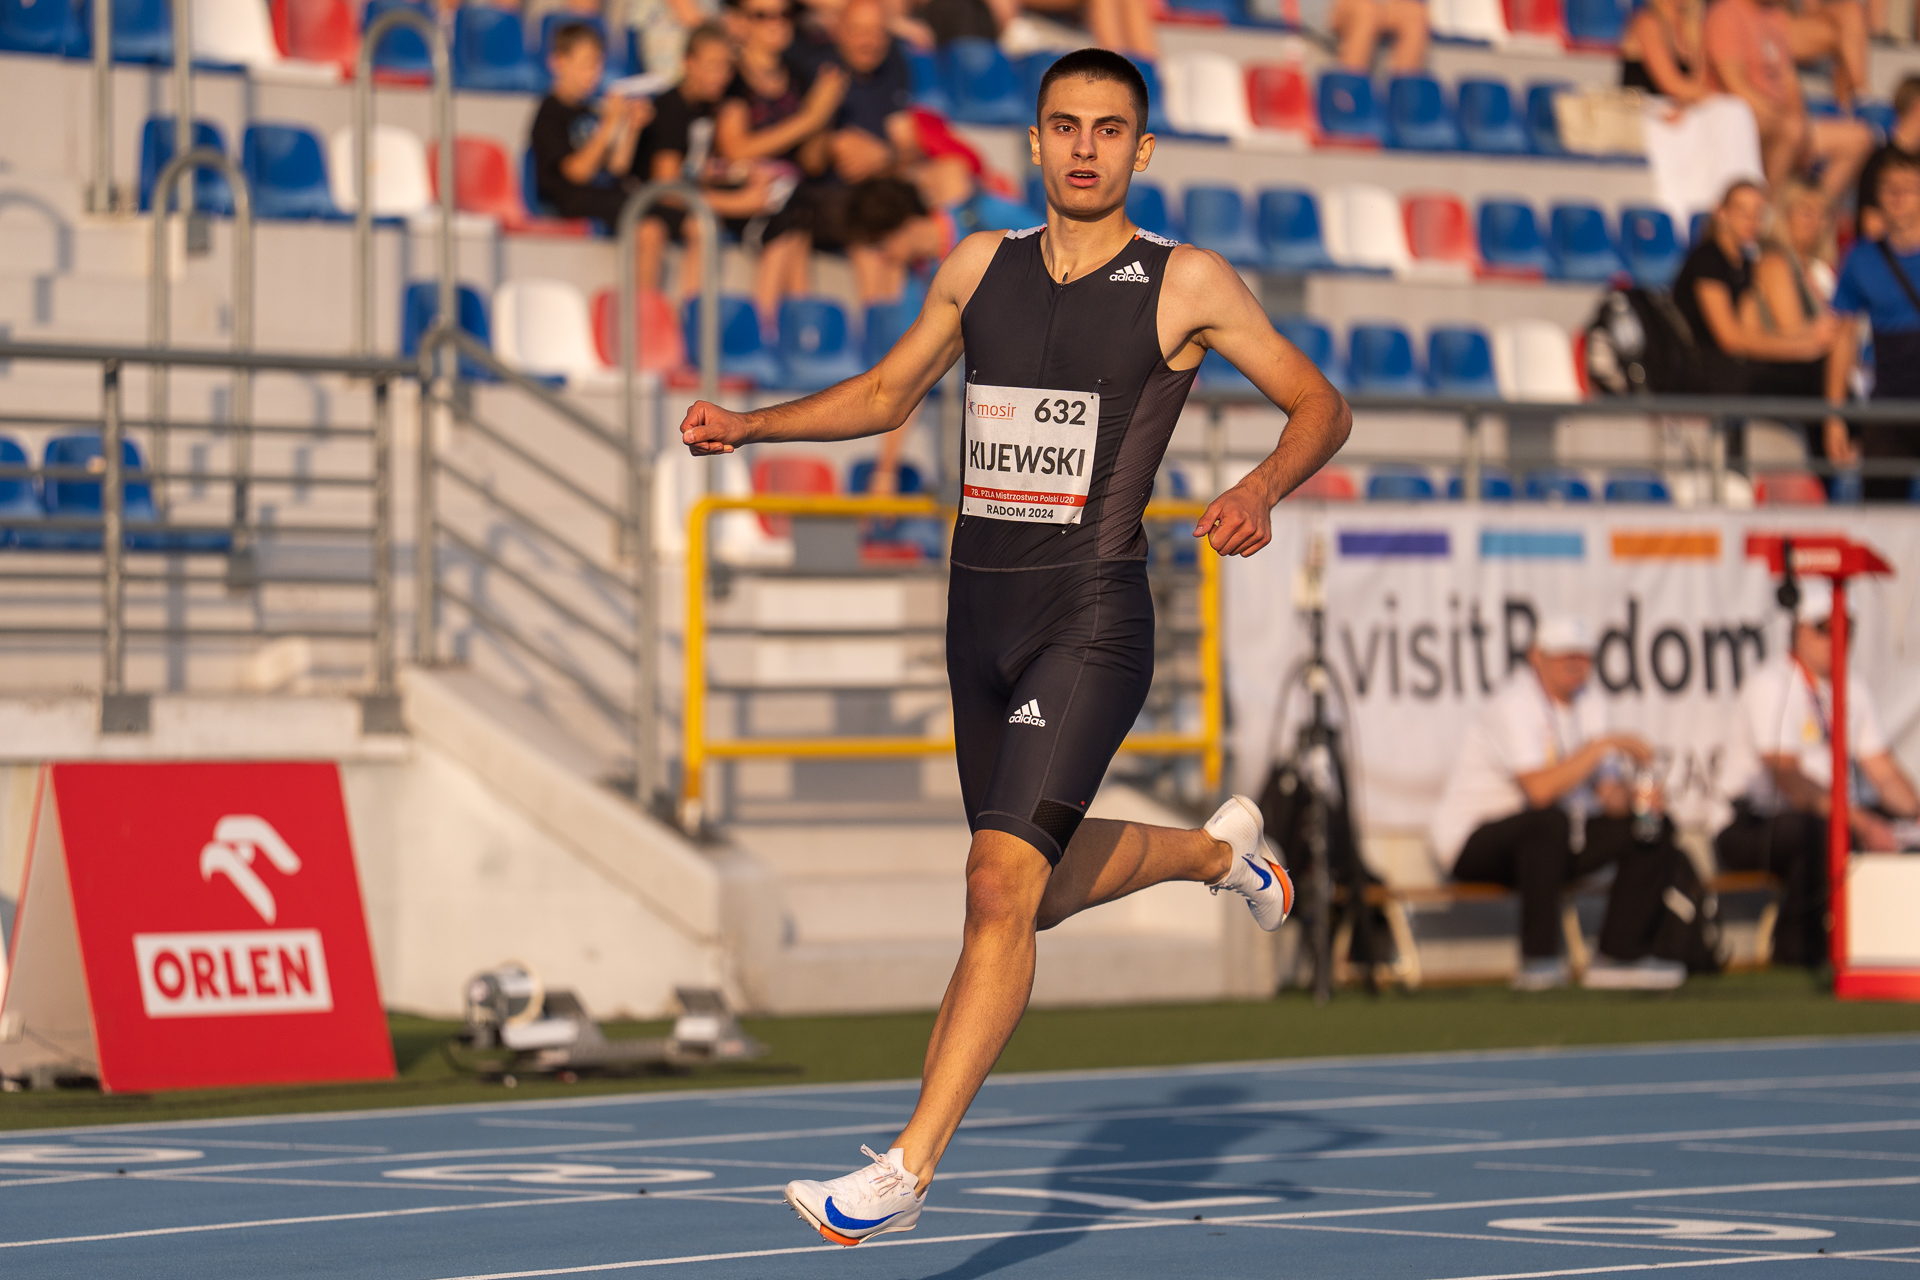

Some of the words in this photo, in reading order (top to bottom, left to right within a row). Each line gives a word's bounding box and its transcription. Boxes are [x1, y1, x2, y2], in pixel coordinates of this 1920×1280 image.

[1109, 273, 1150, 284] adidas
[977, 402, 1017, 418] mosir
[1034, 398, 1087, 426] 632
[969, 439, 1086, 477] KIJEWSKI
[971, 488, 981, 497] 78.
[981, 489, 995, 498] PZLA
[995, 491, 1038, 502] Mistrzostwa
[1039, 494, 1059, 503] Polski
[1059, 495, 1075, 504] U20
[986, 504, 1026, 518] RADOM
[1028, 507, 1054, 519] 2024
[1341, 595, 1766, 697] visitRdom
[1008, 714, 1046, 727] adidas
[152, 944, 314, 1001] ORLEN
